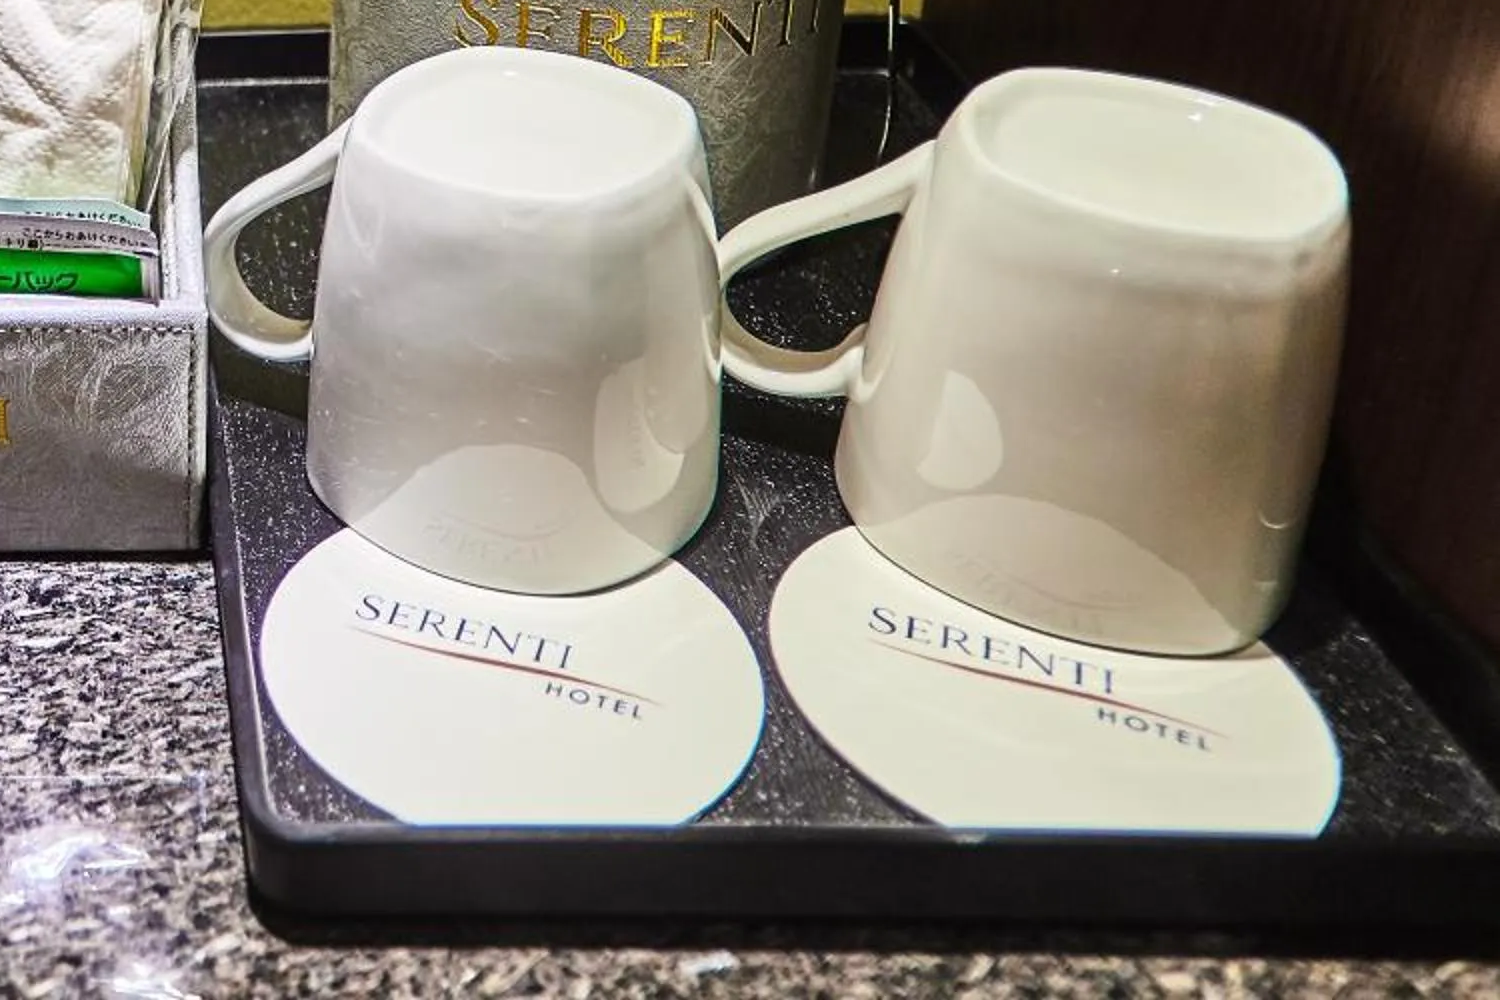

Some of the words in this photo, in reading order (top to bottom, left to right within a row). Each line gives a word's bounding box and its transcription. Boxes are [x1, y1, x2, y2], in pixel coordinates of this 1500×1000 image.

[355, 593, 573, 669] SERENTI
[868, 606, 1115, 694] SERENTI
[545, 681, 643, 720] HOTEL
[1097, 706, 1213, 752] HOTEL
